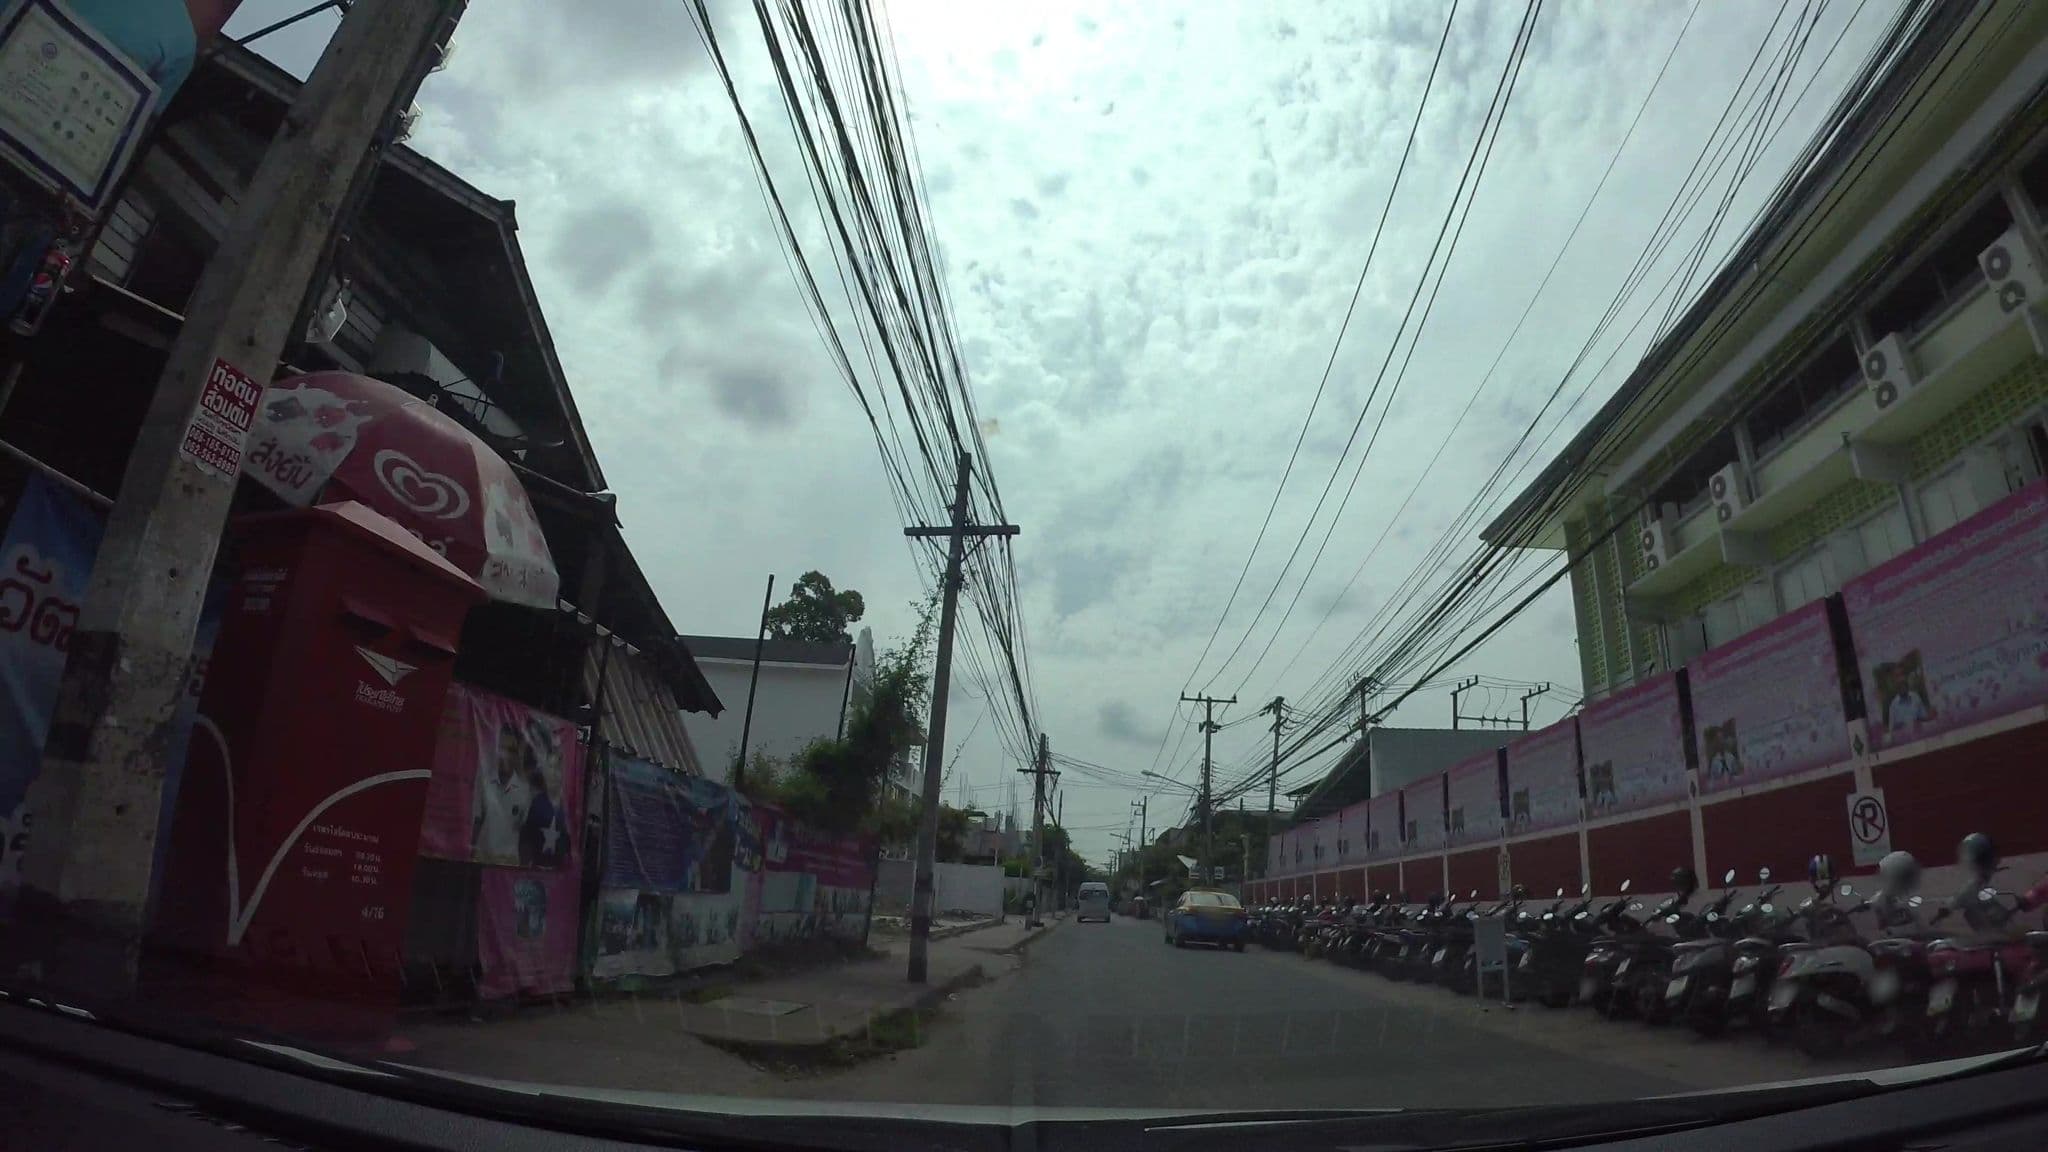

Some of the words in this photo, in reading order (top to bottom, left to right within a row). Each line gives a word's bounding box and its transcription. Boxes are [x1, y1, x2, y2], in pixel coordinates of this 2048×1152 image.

[204, 384, 249, 428] ส้วมตัน
[213, 365, 257, 405] ท่อตัน
